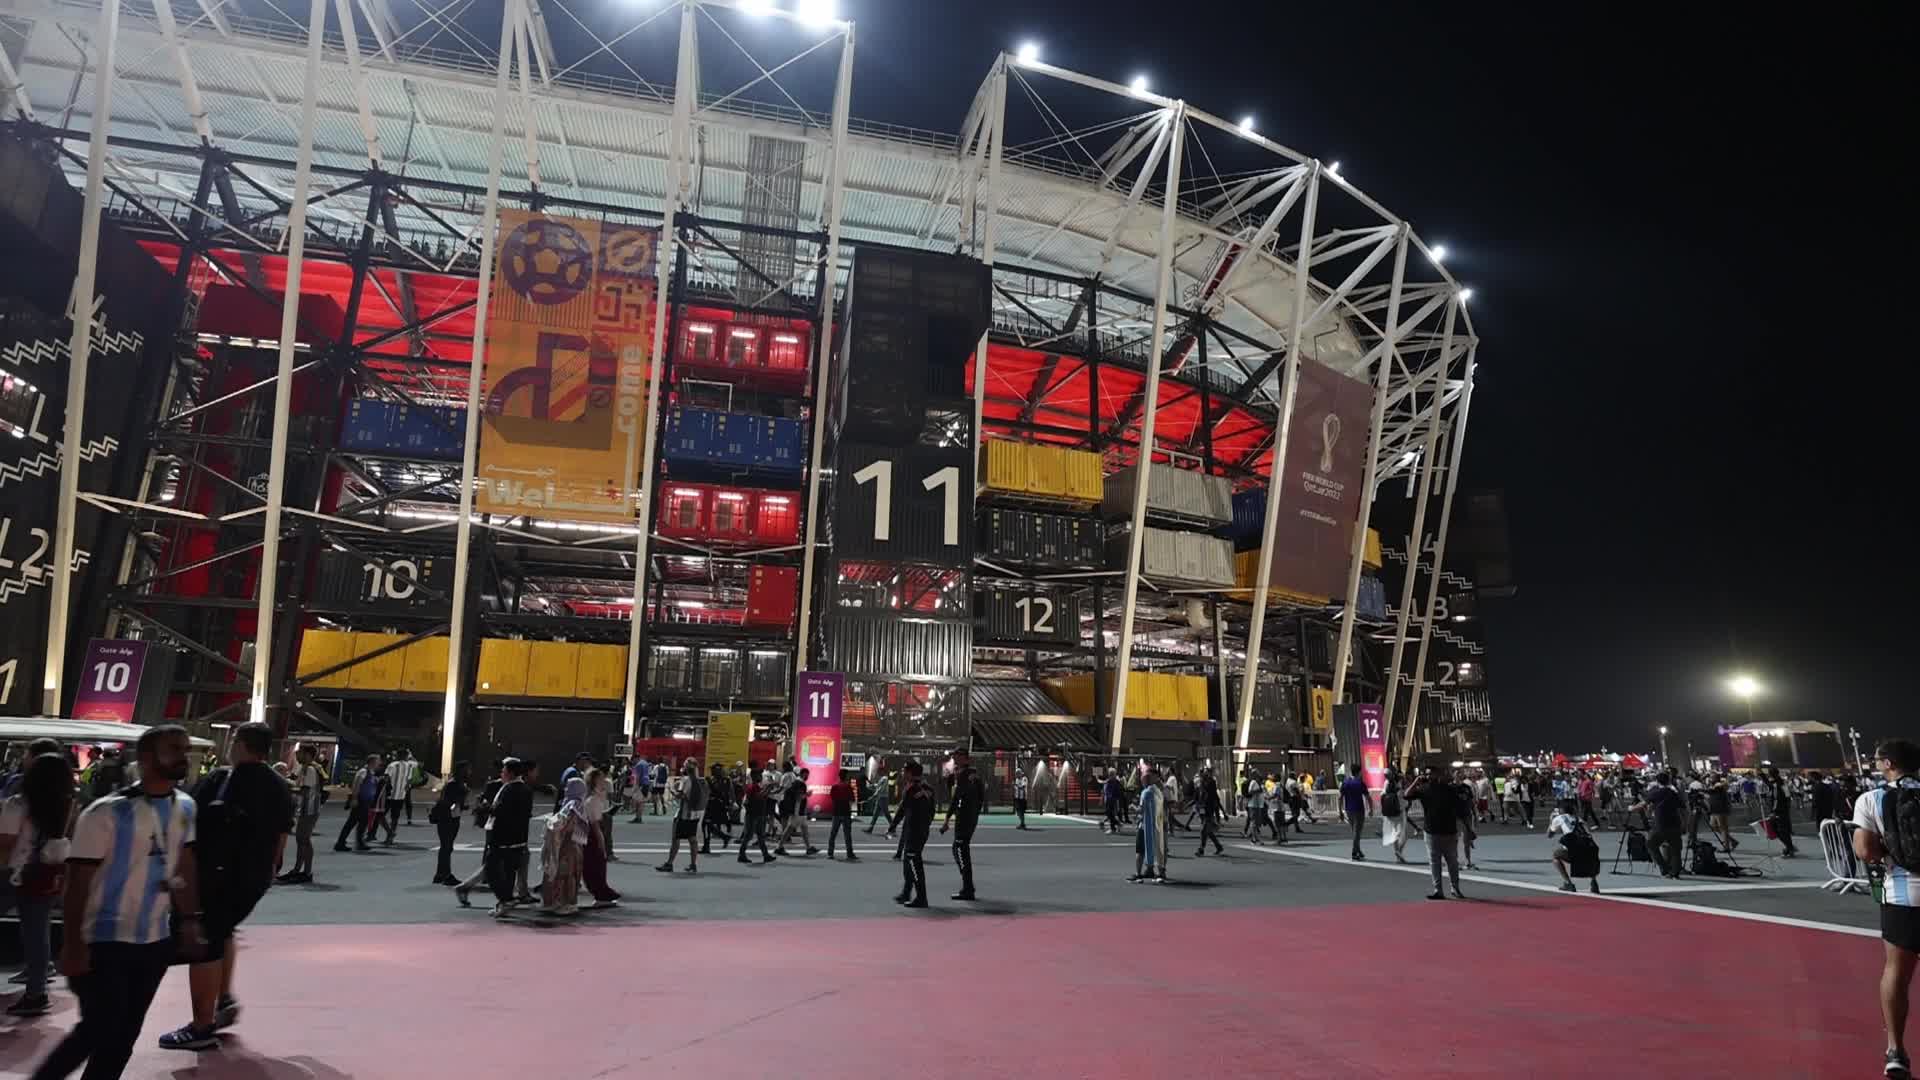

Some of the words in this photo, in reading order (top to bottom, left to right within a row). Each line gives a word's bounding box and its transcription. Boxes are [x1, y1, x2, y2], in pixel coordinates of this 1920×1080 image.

[853, 459, 960, 546] 11
[363, 559, 418, 600] 10
[1015, 597, 1054, 633] 12
[93, 661, 131, 693] 10
[809, 691, 831, 718] 11
[1363, 718, 1380, 739] 12
